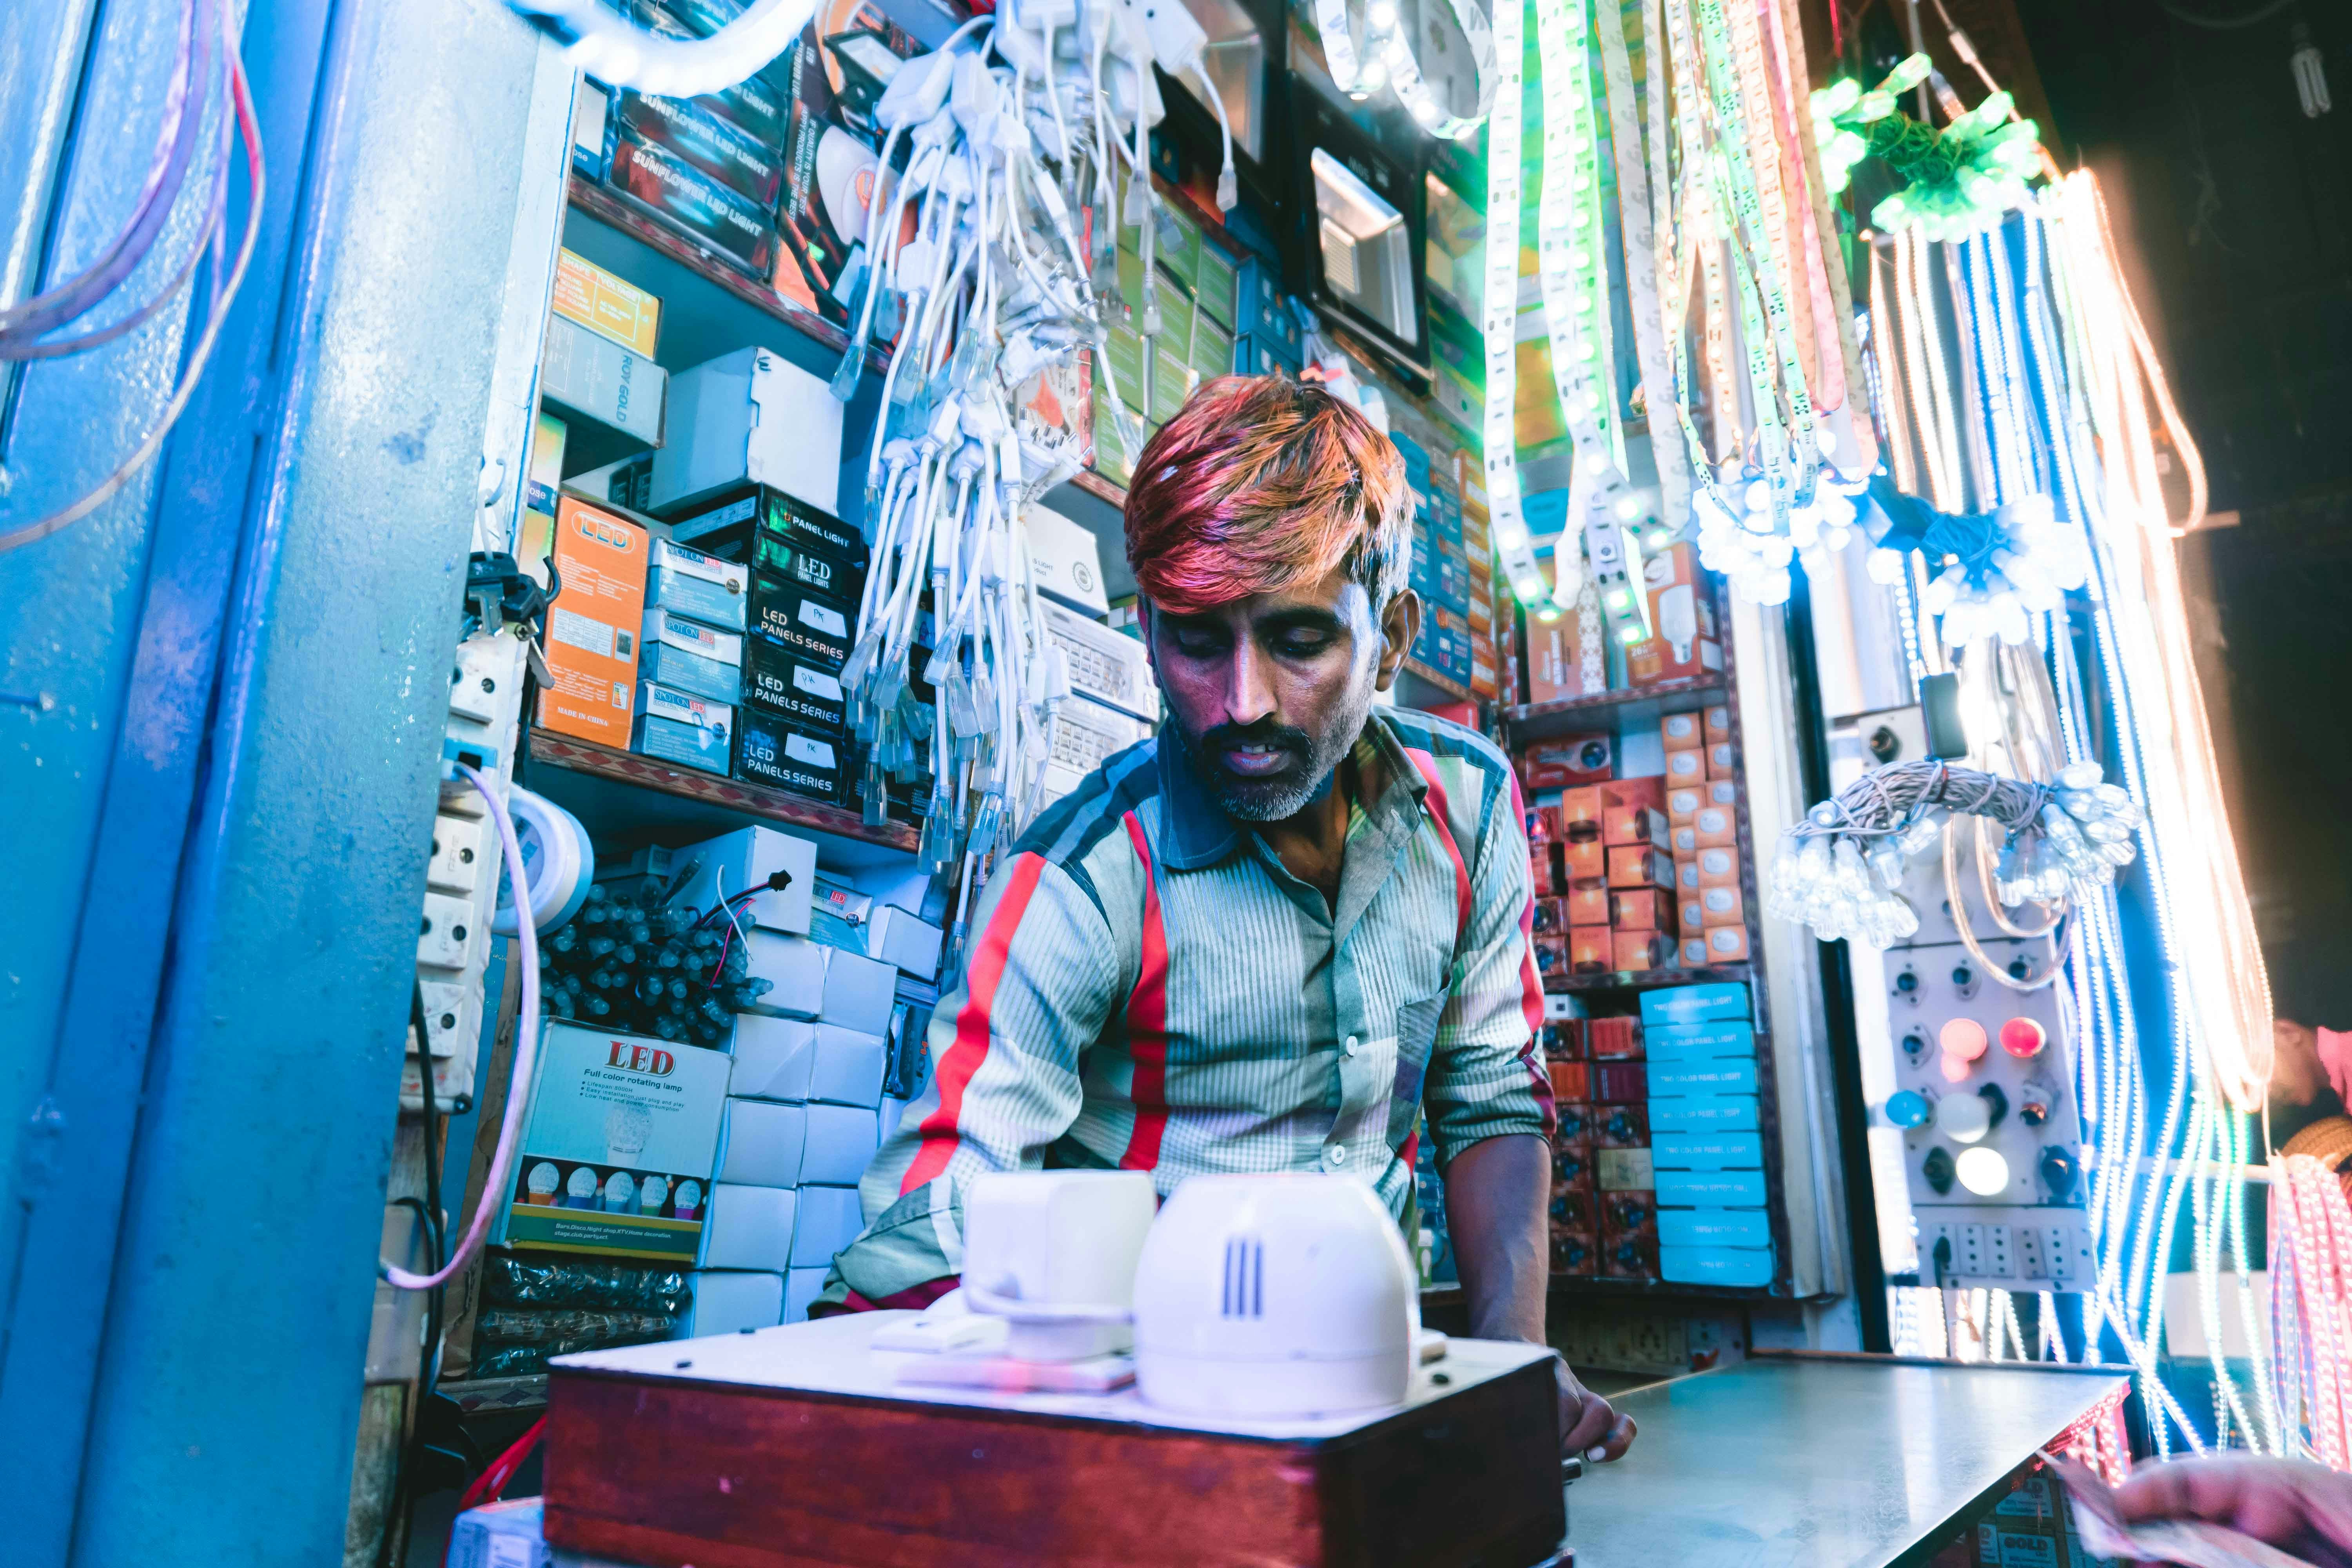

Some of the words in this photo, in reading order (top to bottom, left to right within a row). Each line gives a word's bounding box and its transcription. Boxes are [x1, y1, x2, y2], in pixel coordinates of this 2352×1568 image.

[742, 89, 774, 117] LIGHT
[640, 92, 714, 143] SUNFLOWER
[715, 135, 736, 155] LED
[737, 149, 769, 177] LIGHT
[809, 119, 816, 129] IF
[795, 130, 805, 172] PRODUCTS
[806, 128, 815, 161] QUALITY
[793, 172, 800, 182] IS
[805, 162, 811, 170] IS
[632, 151, 706, 203] SUNFLOWER
[707, 195, 729, 215] LED
[728, 209, 762, 236] LIGHT
[791, 183, 800, 198] THE
[802, 171, 810, 195] YOUR
[788, 199, 797, 221] BEST
[799, 195, 807, 216] TEST
[563, 256, 590, 276] SHAPE
[601, 277, 638, 301] VOLTAGE
[617, 384, 629, 422] GOLD
[581, 516, 627, 548] LED
[793, 516, 822, 536] PANEL
[824, 530, 849, 547] LIGHT
[668, 545, 687, 558] SPOT
[691, 552, 704, 562] ON
[705, 557, 720, 567] LED
[798, 554, 831, 579] LED
[1038, 560, 1053, 571] LIGHT
[798, 571, 812, 583] PANEL
[813, 577, 829, 588] LIGHTS
[763, 606, 787, 625] LED
[665, 620, 684, 631] SPOT
[686, 626, 698, 638] ON
[699, 631, 713, 642] LED
[675, 632, 697, 643] FRIENDLY
[698, 639, 713, 649] LIGHTS
[761, 621, 803, 644] PANELS
[806, 638, 843, 659] SERIES
[758, 673, 783, 692] LED
[655, 690, 675, 702] SPOT
[677, 697, 689, 708] ON
[690, 701, 704, 712] LED
[755, 688, 798, 710] PANELS
[800, 703, 840, 724] SERIES
[557, 706, 576, 717] MADE
[587, 715, 608, 726] CHINA
[750, 744, 774, 762] LED
[748, 759, 790, 780] PANELS
[793, 772, 832, 791] SERIES
[831, 891, 845, 902] LED
[1691, 999, 1712, 1007] PANEL
[1713, 996, 1733, 1005] LIGHT
[1695, 1036, 1715, 1045] PANEL
[1718, 1034, 1737, 1043] LIGHT
[604, 1040, 676, 1078] LED
[584, 1069, 601, 1078] Full
[603, 1072, 625, 1081] color
[627, 1077, 661, 1089] rotating
[663, 1083, 682, 1093] lamp
[645, 1102, 679, 1112] consumption
[2004, 1537, 2047, 1551] GOLD
